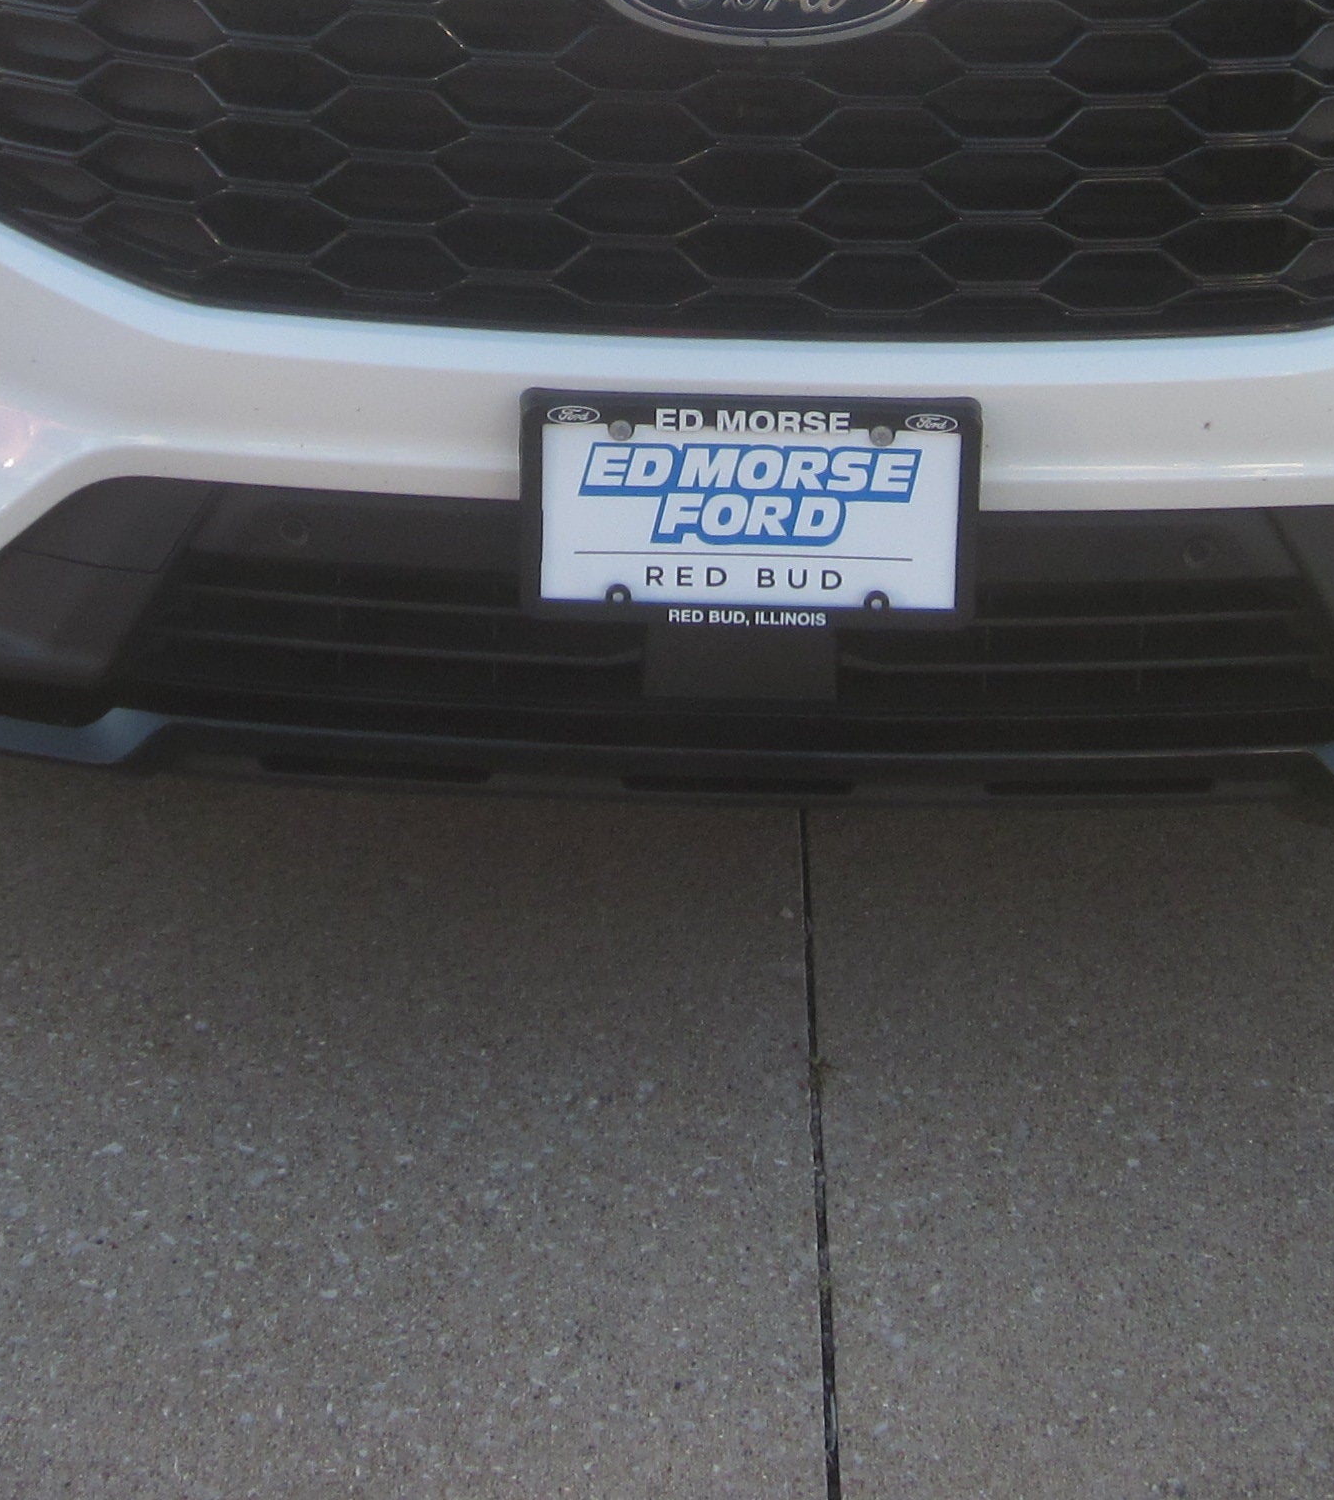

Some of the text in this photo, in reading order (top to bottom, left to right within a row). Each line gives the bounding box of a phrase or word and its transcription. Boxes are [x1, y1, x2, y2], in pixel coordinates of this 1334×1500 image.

[558, 409, 590, 421] Ford
[655, 408, 851, 435] ED MORSE
[916, 417, 948, 429] Ford
[581, 444, 920, 499] ED MORSE
[654, 493, 846, 543] FORD
[645, 565, 844, 590] RED BUD
[668, 609, 827, 626] RED BUD, ILLINOIS
